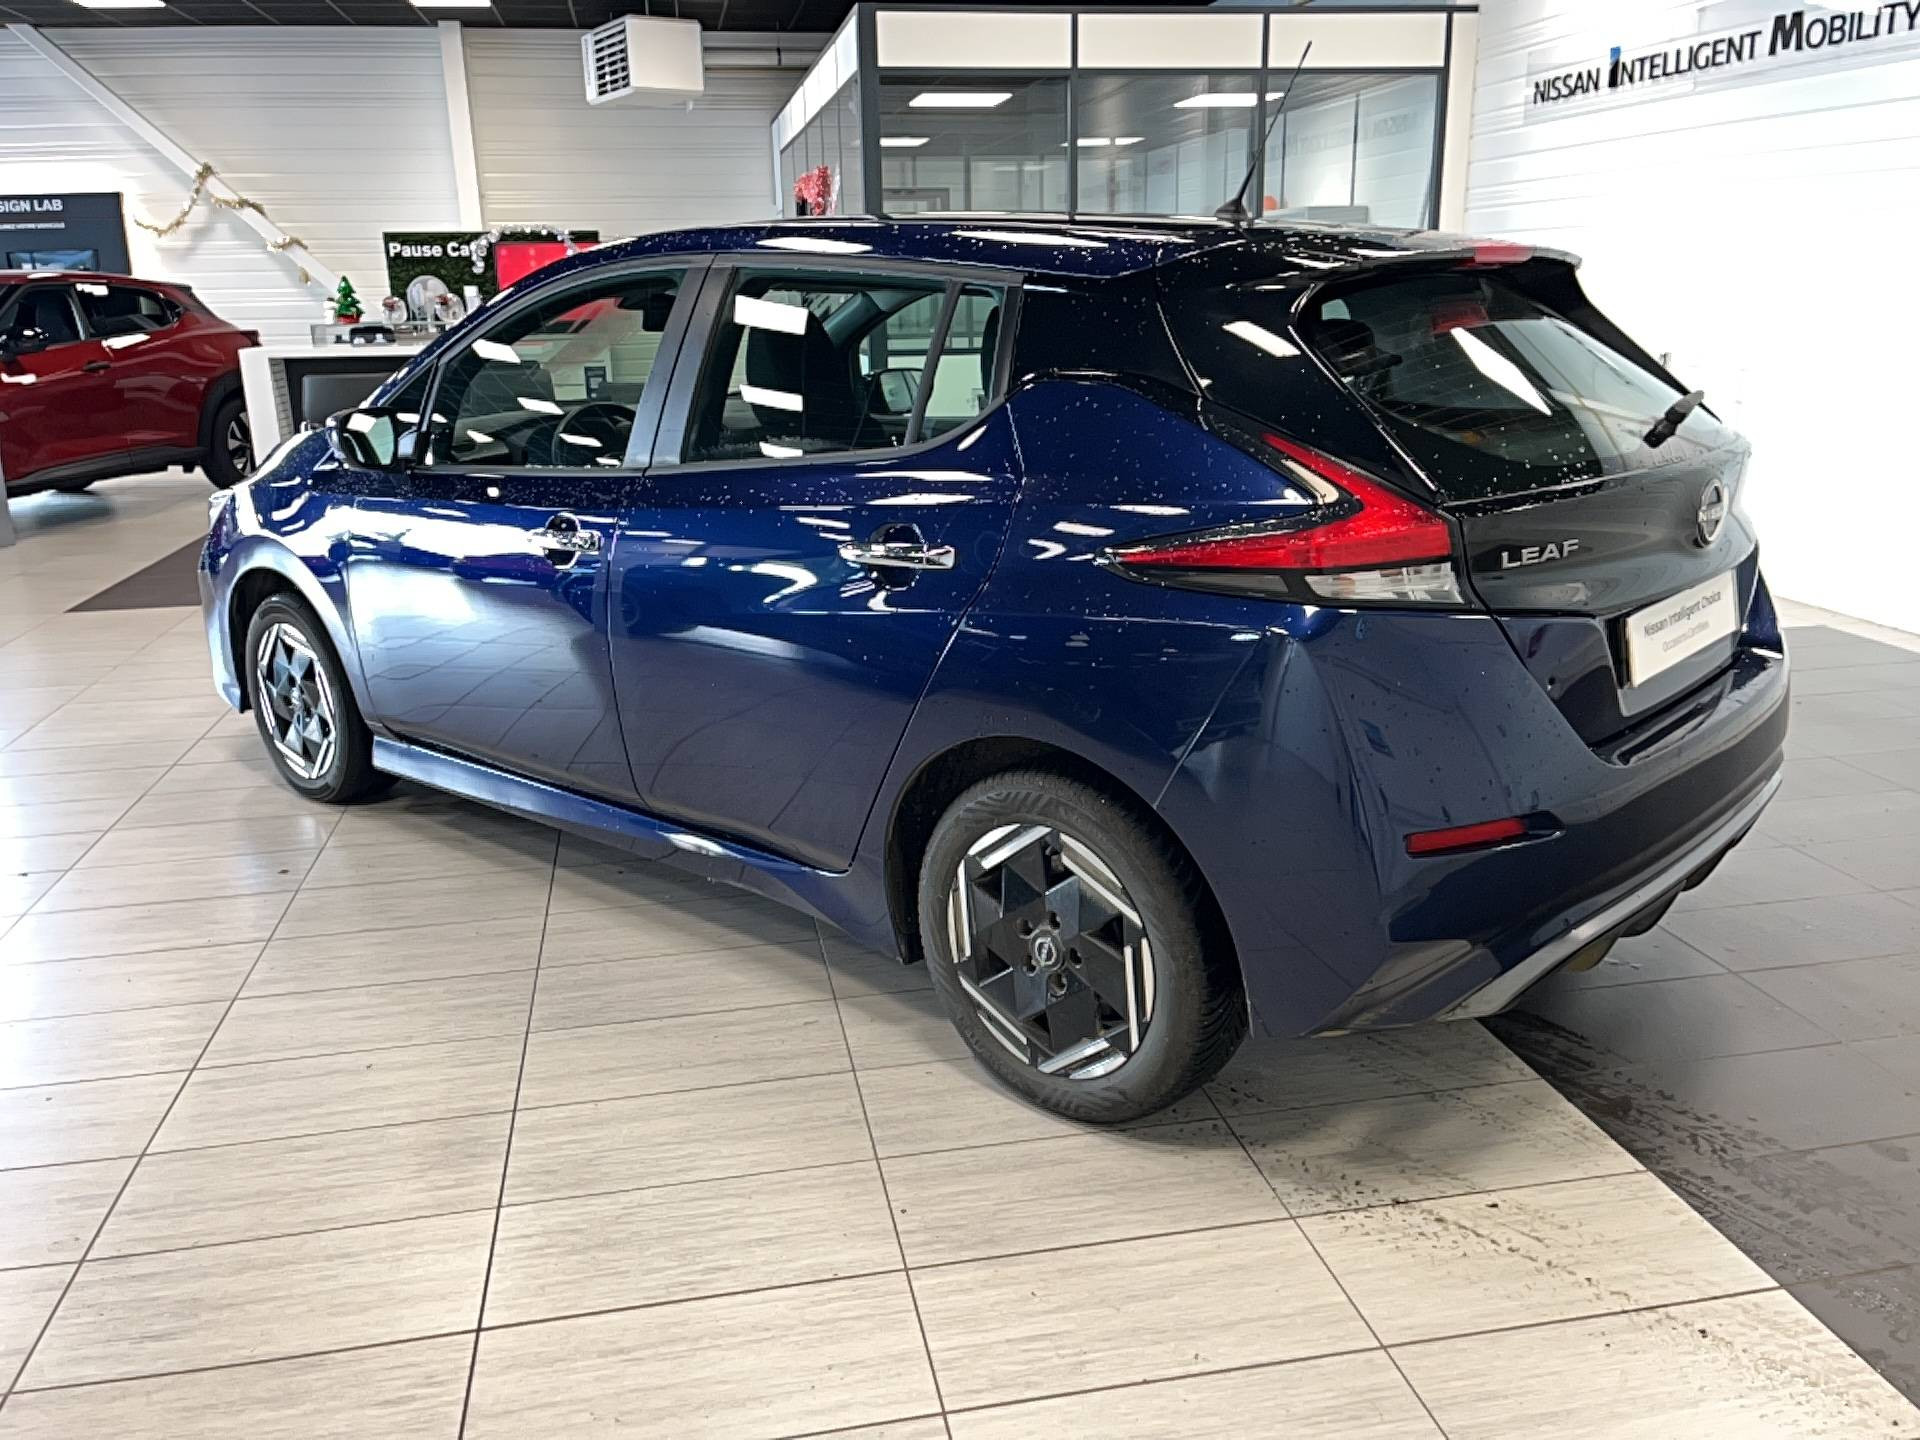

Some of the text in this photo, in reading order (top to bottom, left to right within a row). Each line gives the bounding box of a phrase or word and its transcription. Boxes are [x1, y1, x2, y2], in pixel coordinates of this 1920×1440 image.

[1533, 0, 1920, 105] NISSAN INTELLIGENT MOBILITY
[33, 198, 63, 212] LAB
[388, 241, 487, 258] Pause Ca
[1501, 538, 1579, 569] LEAF
